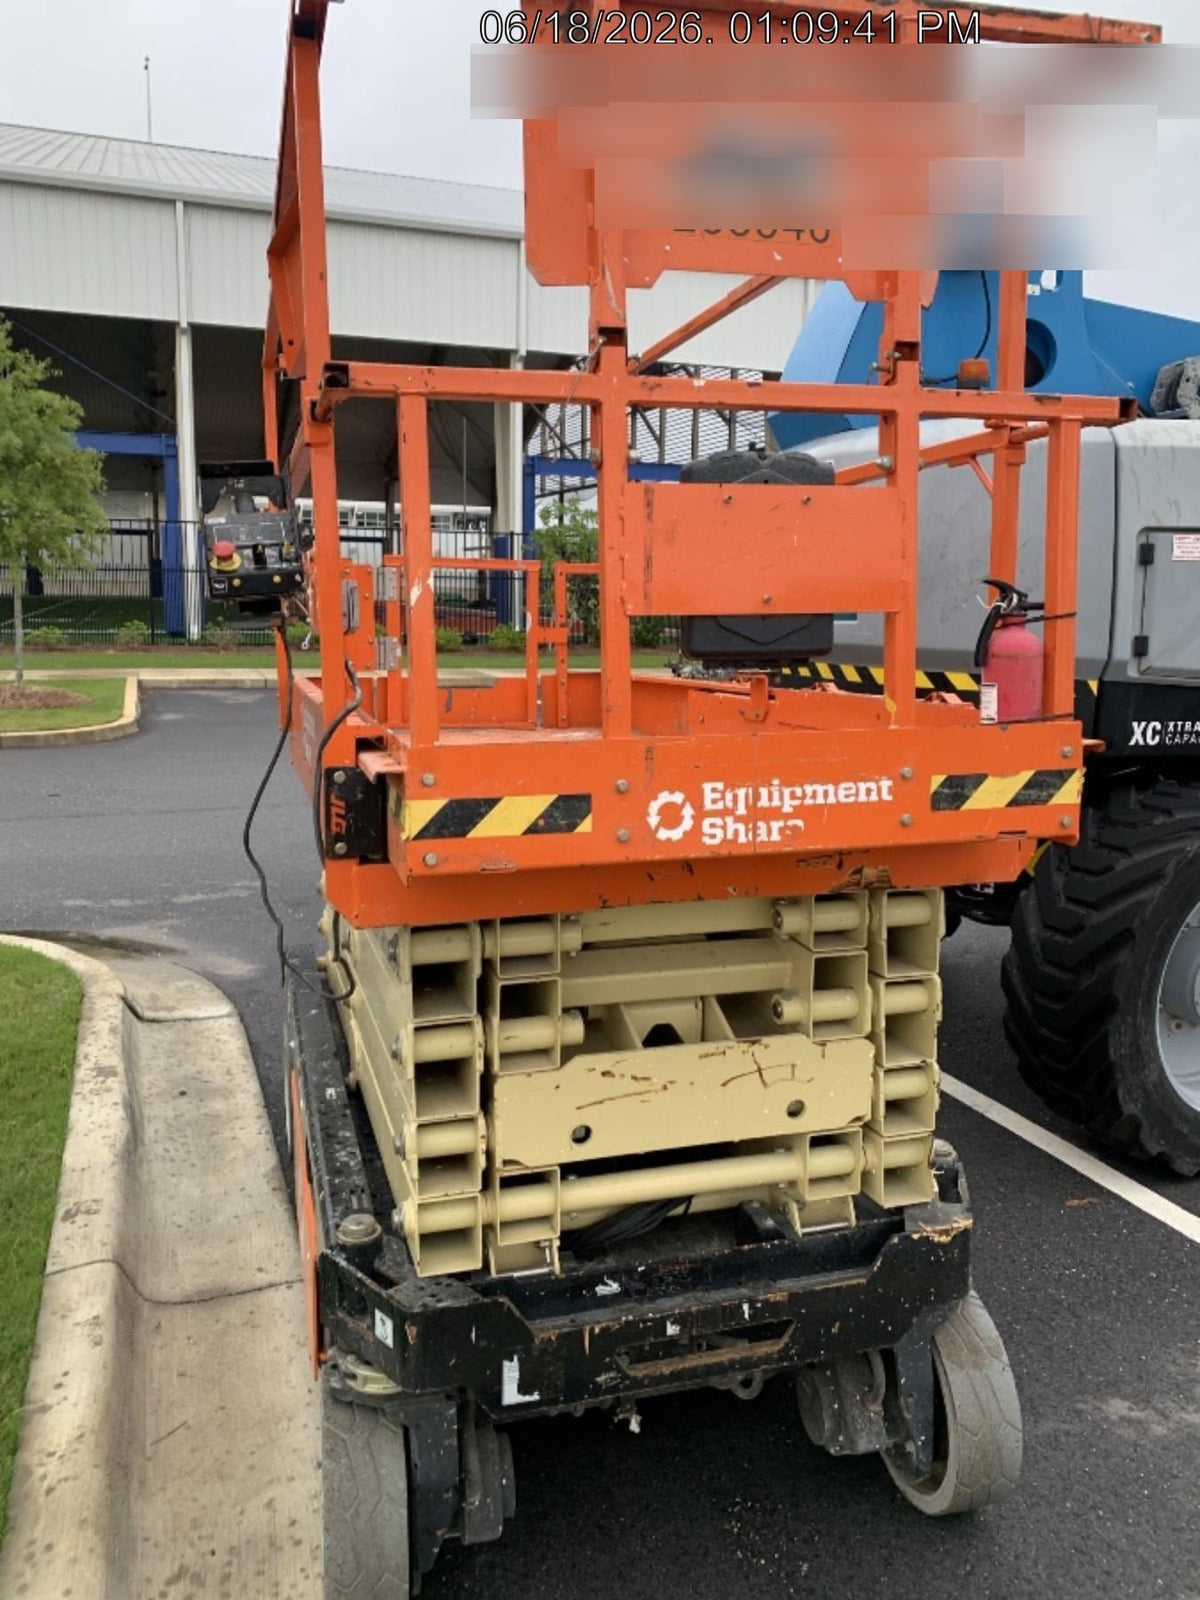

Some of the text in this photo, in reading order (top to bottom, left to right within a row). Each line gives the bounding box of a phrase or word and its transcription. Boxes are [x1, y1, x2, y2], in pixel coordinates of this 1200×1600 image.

[1128, 721, 1161, 746] XC
[1165, 733, 1200, 745] CAPA
[702, 777, 893, 815] Equipment
[329, 792, 347, 834] JLG
